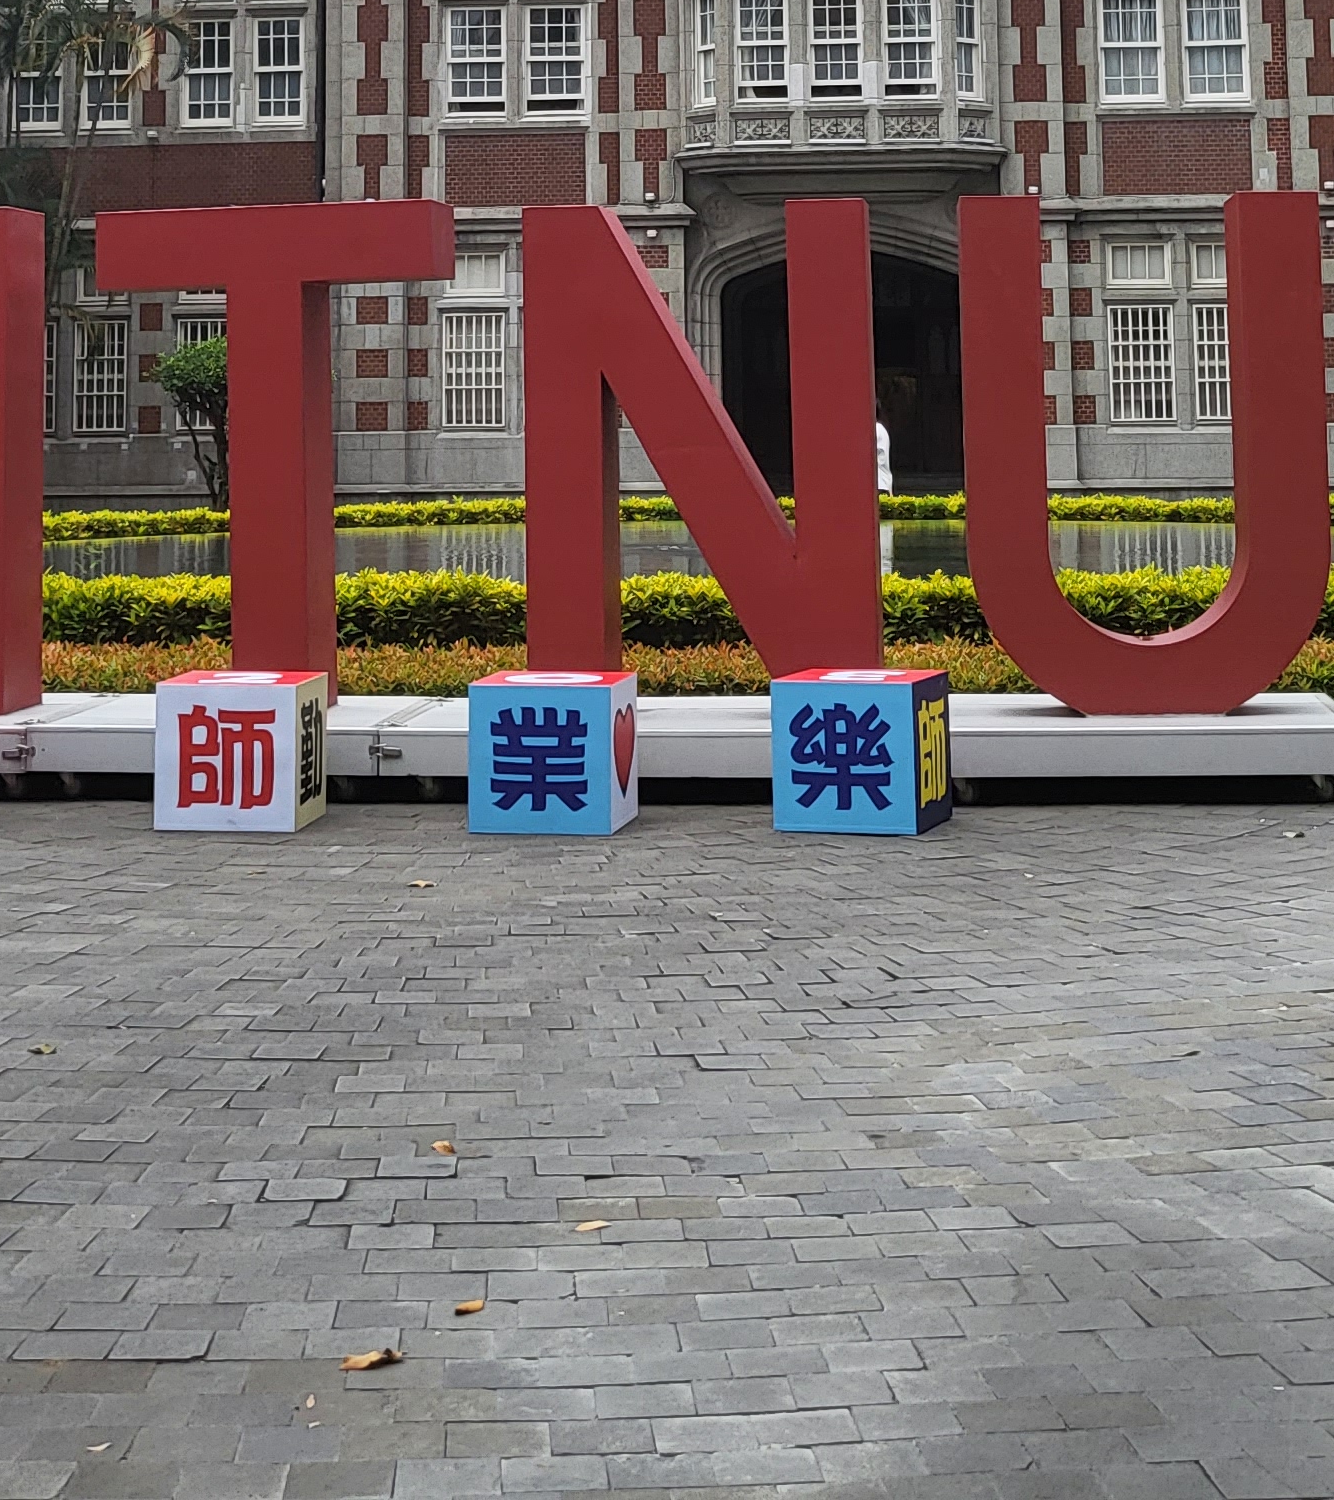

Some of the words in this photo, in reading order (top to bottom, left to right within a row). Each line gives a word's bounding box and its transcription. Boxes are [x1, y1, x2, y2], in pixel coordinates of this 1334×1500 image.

[176, 704, 276, 810] 師
[299, 697, 323, 806] 勤
[490, 706, 588, 812] 業
[789, 702, 895, 811] 樂
[917, 696, 947, 809] 師
